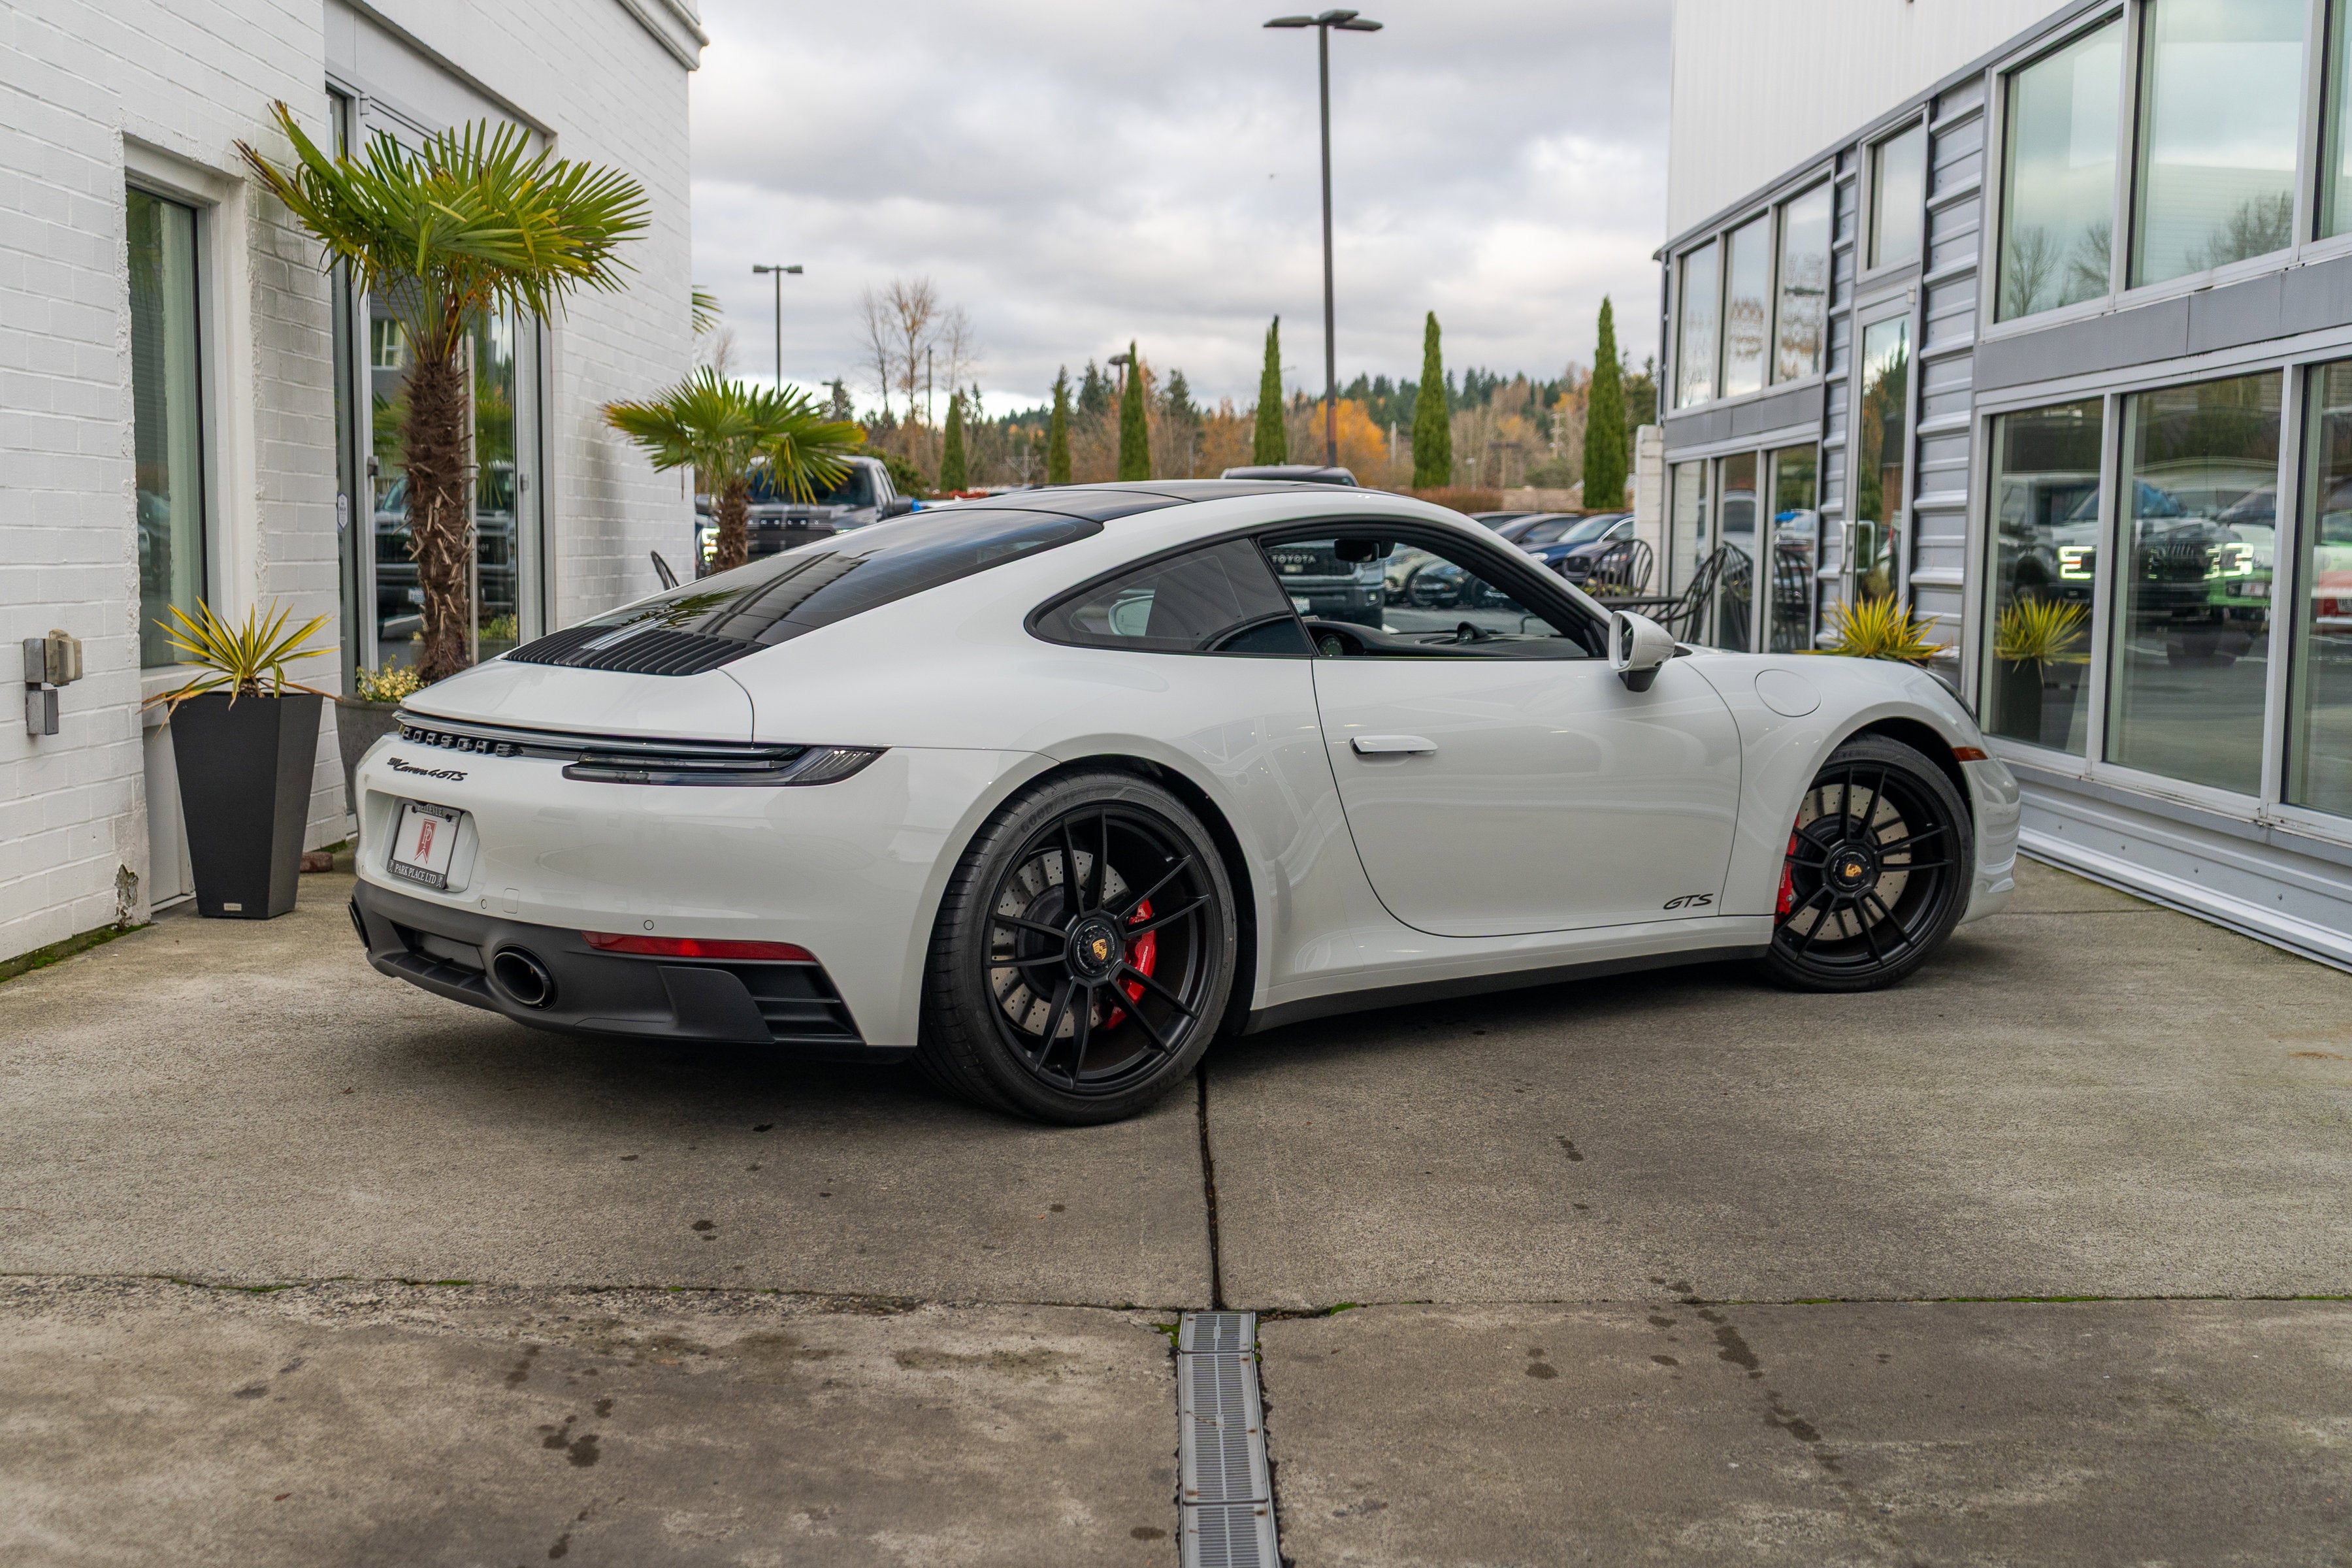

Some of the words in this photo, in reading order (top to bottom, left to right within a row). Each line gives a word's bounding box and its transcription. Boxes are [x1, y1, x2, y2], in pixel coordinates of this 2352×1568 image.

[1271, 554, 1316, 564] TOYOTA
[401, 727, 514, 757] PORSCHE
[436, 770, 468, 781] GTS
[394, 863, 408, 876] PARK
[408, 868, 425, 881] PLACE
[425, 872, 436, 884] LTD
[1663, 893, 1714, 910] GTS
[1139, 945, 1149, 973] PORSC
